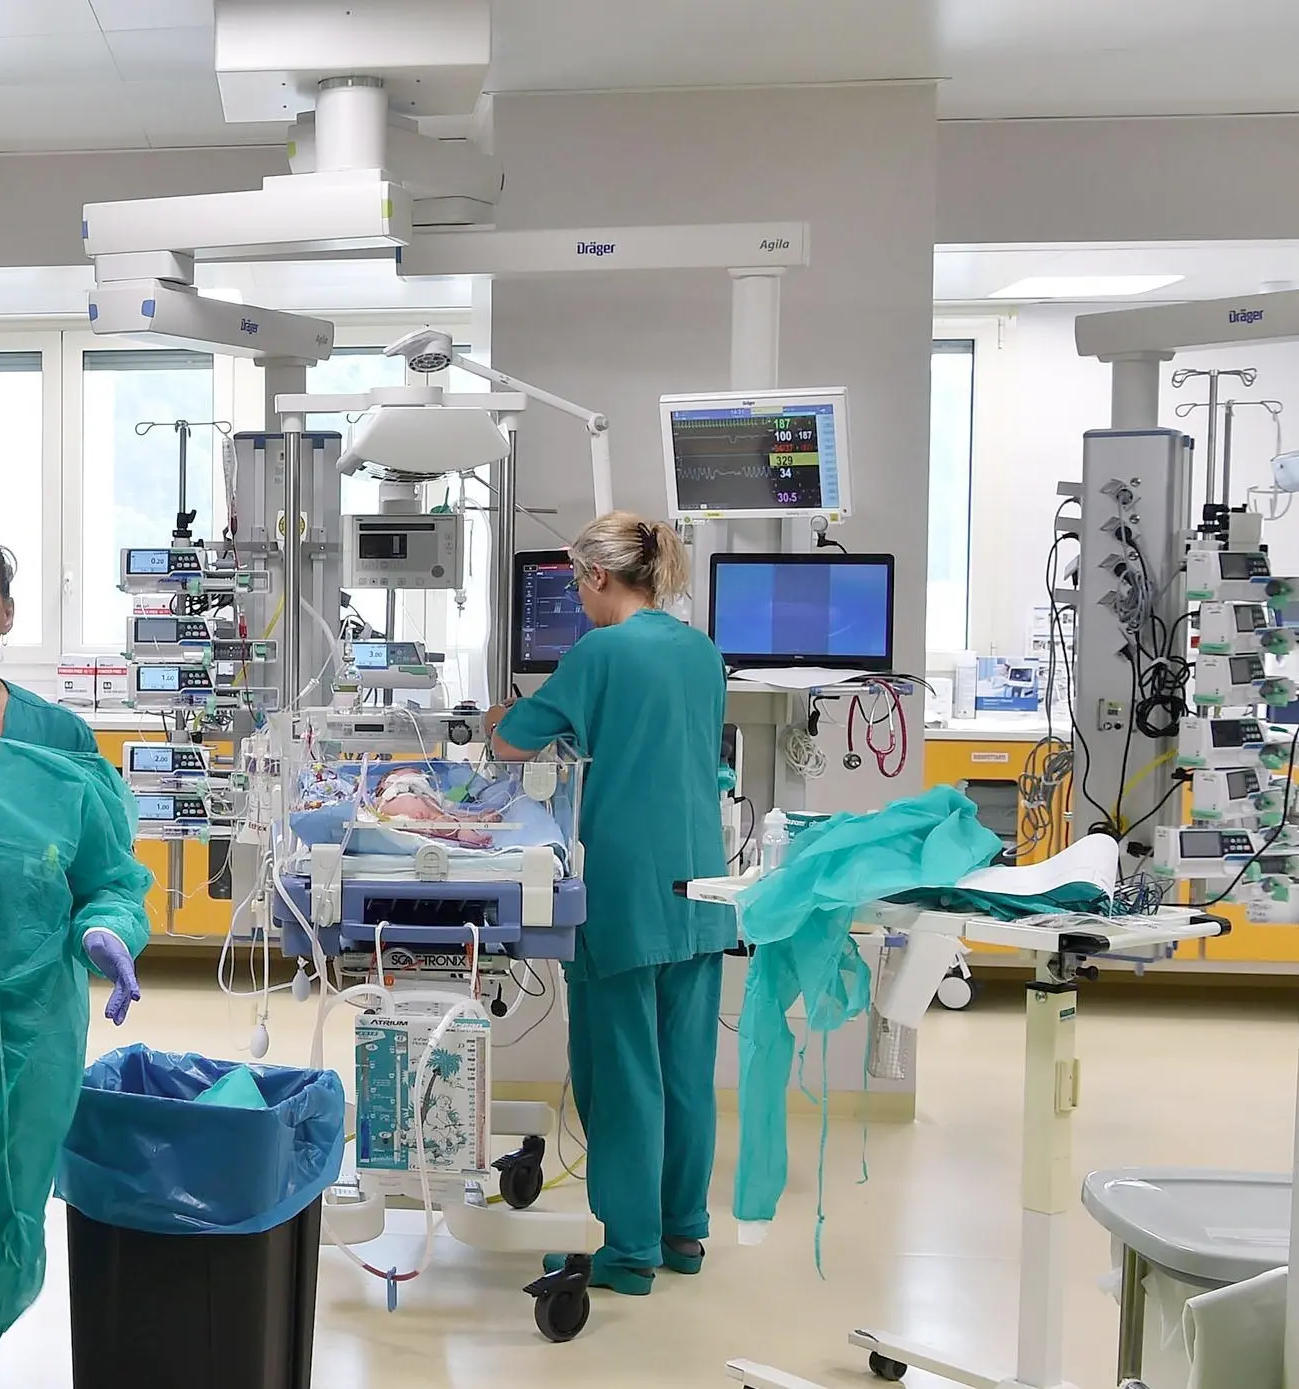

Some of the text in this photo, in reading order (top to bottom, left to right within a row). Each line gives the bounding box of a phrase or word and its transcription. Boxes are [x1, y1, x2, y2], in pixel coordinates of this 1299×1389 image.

[576, 241, 616, 257] Dräger
[759, 239, 790, 252] Agila
[1228, 308, 1265, 324] Dräger
[773, 418, 791, 430] 187
[773, 430, 813, 442] 100 187
[775, 455, 794, 466] 329
[778, 467, 793, 479] 34
[776, 492, 799, 504] 30.5
[390, 954, 467, 967] SCATRONIX
[369, 1018, 409, 1027] ATRIUM
